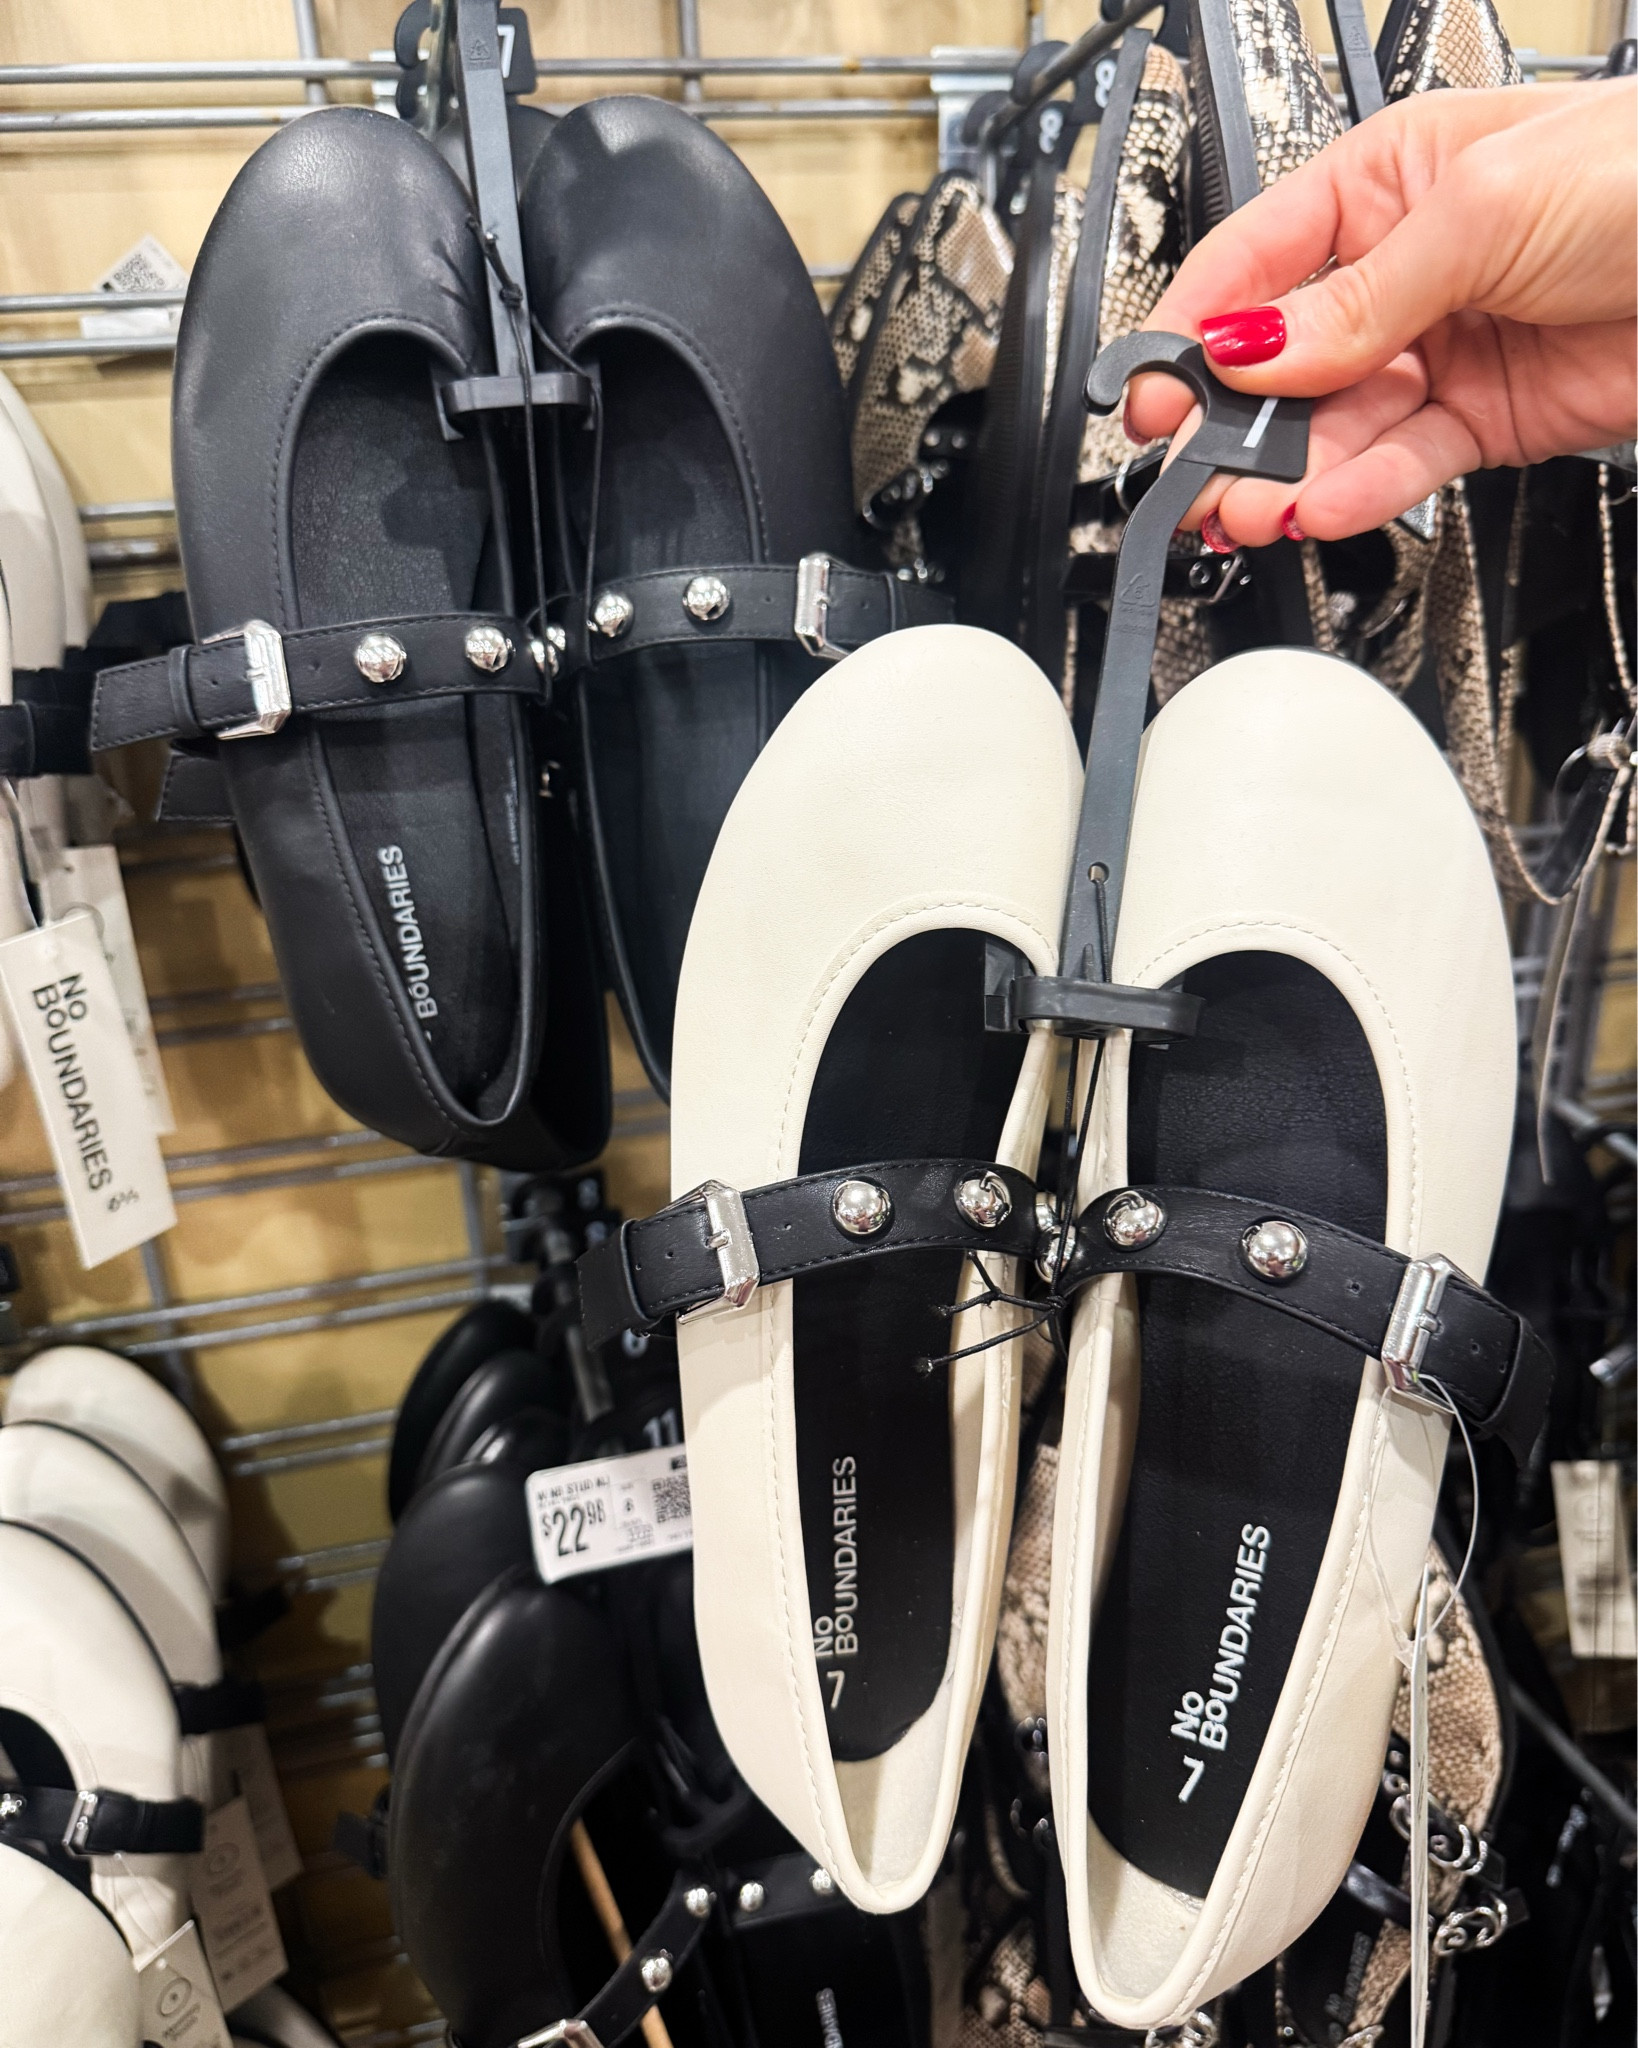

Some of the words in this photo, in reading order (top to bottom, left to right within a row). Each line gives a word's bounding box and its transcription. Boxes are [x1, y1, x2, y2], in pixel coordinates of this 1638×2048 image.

[497, 24, 516, 79] 7
[377, 844, 439, 1019] BOUNDARIES
[58, 972, 88, 1021] NO
[32, 983, 113, 1191] BOUNDARIES
[832, 1455, 859, 1655] BOUNDARIES
[813, 1614, 835, 1659] NO
[1198, 1522, 1271, 1751] BOUNDARIES
[826, 1669, 846, 1709] 7
[1170, 1690, 1205, 1743] NO
[1178, 1754, 1205, 1802] 7
